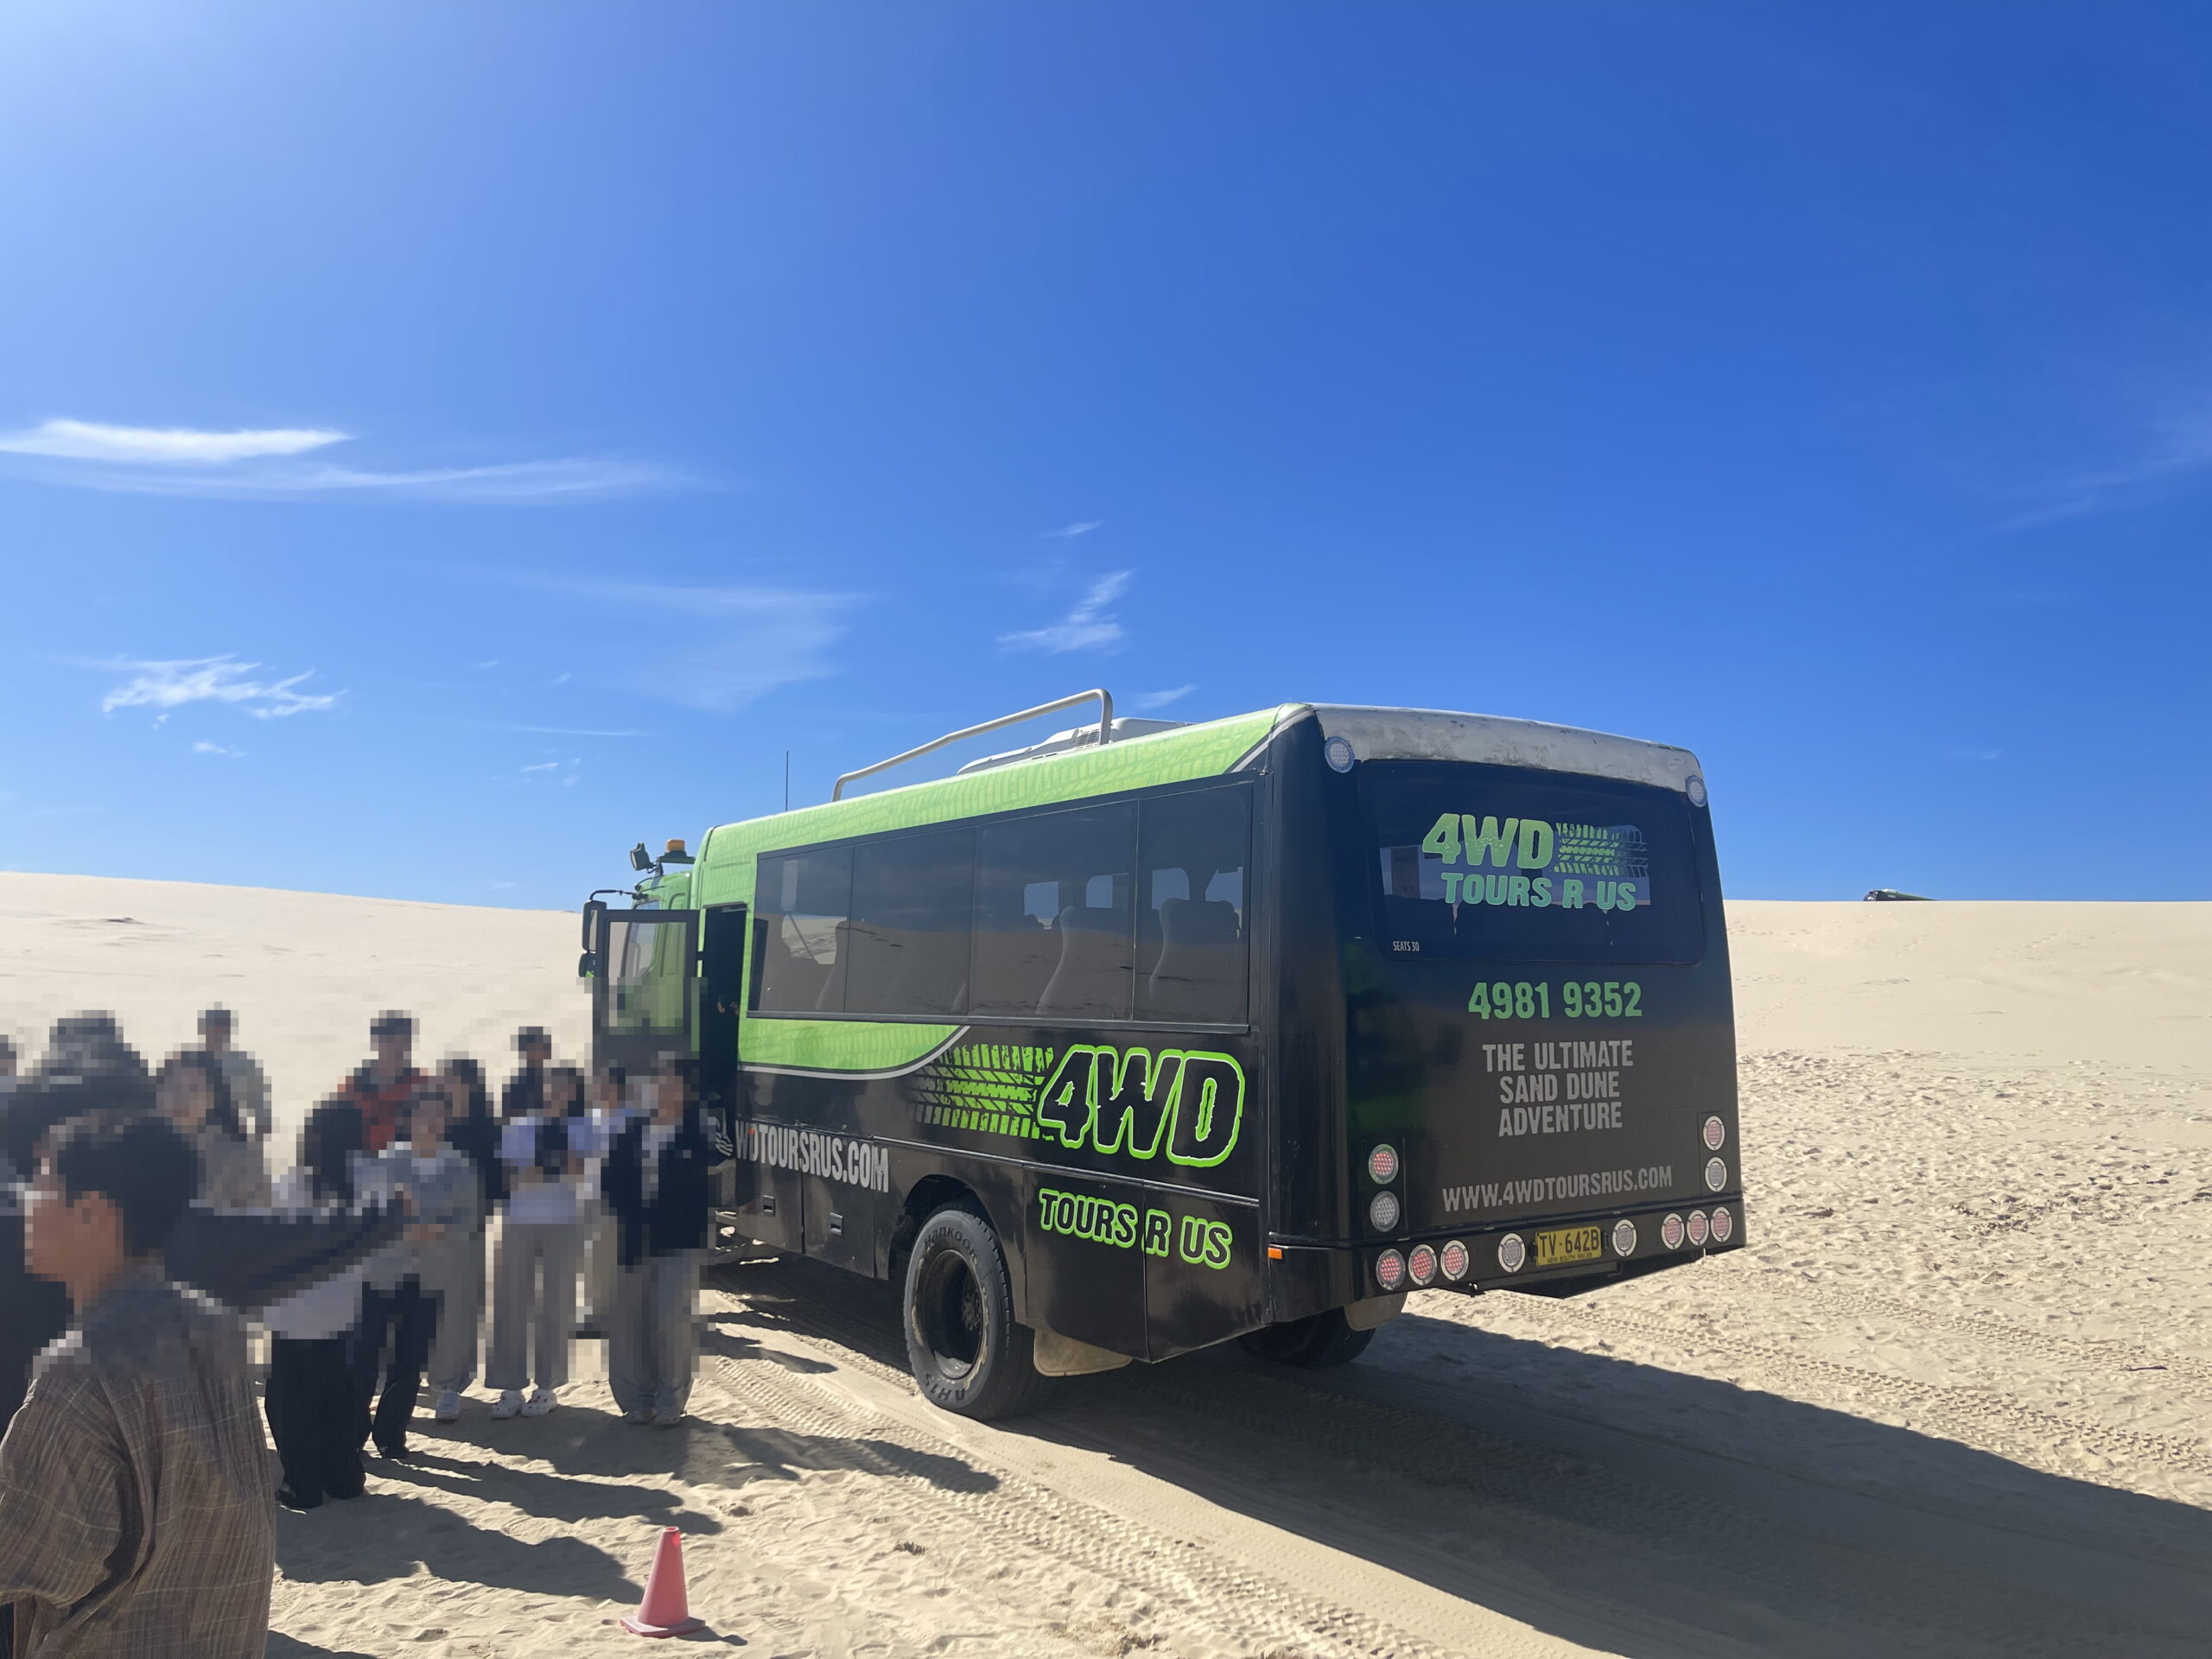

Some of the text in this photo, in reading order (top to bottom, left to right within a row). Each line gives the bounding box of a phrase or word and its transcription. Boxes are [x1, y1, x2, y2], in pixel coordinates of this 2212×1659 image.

[1422, 813, 1554, 869] 4WD
[1440, 872, 1637, 911] TOURS R US
[1392, 940, 1420, 951] SEATS 30
[1469, 982, 1643, 1020] 4981 9352
[1482, 1039, 1634, 1072] THE ULTIMATE
[1038, 1043, 1246, 1167] 4WD
[1499, 1071, 1621, 1104] SAND DUNE
[1498, 1101, 1624, 1137] ADVENTURE
[1442, 1165, 1673, 1212] WWW.4WDTOURSRUS.COM
[1039, 1187, 1233, 1270] TOURS R US
